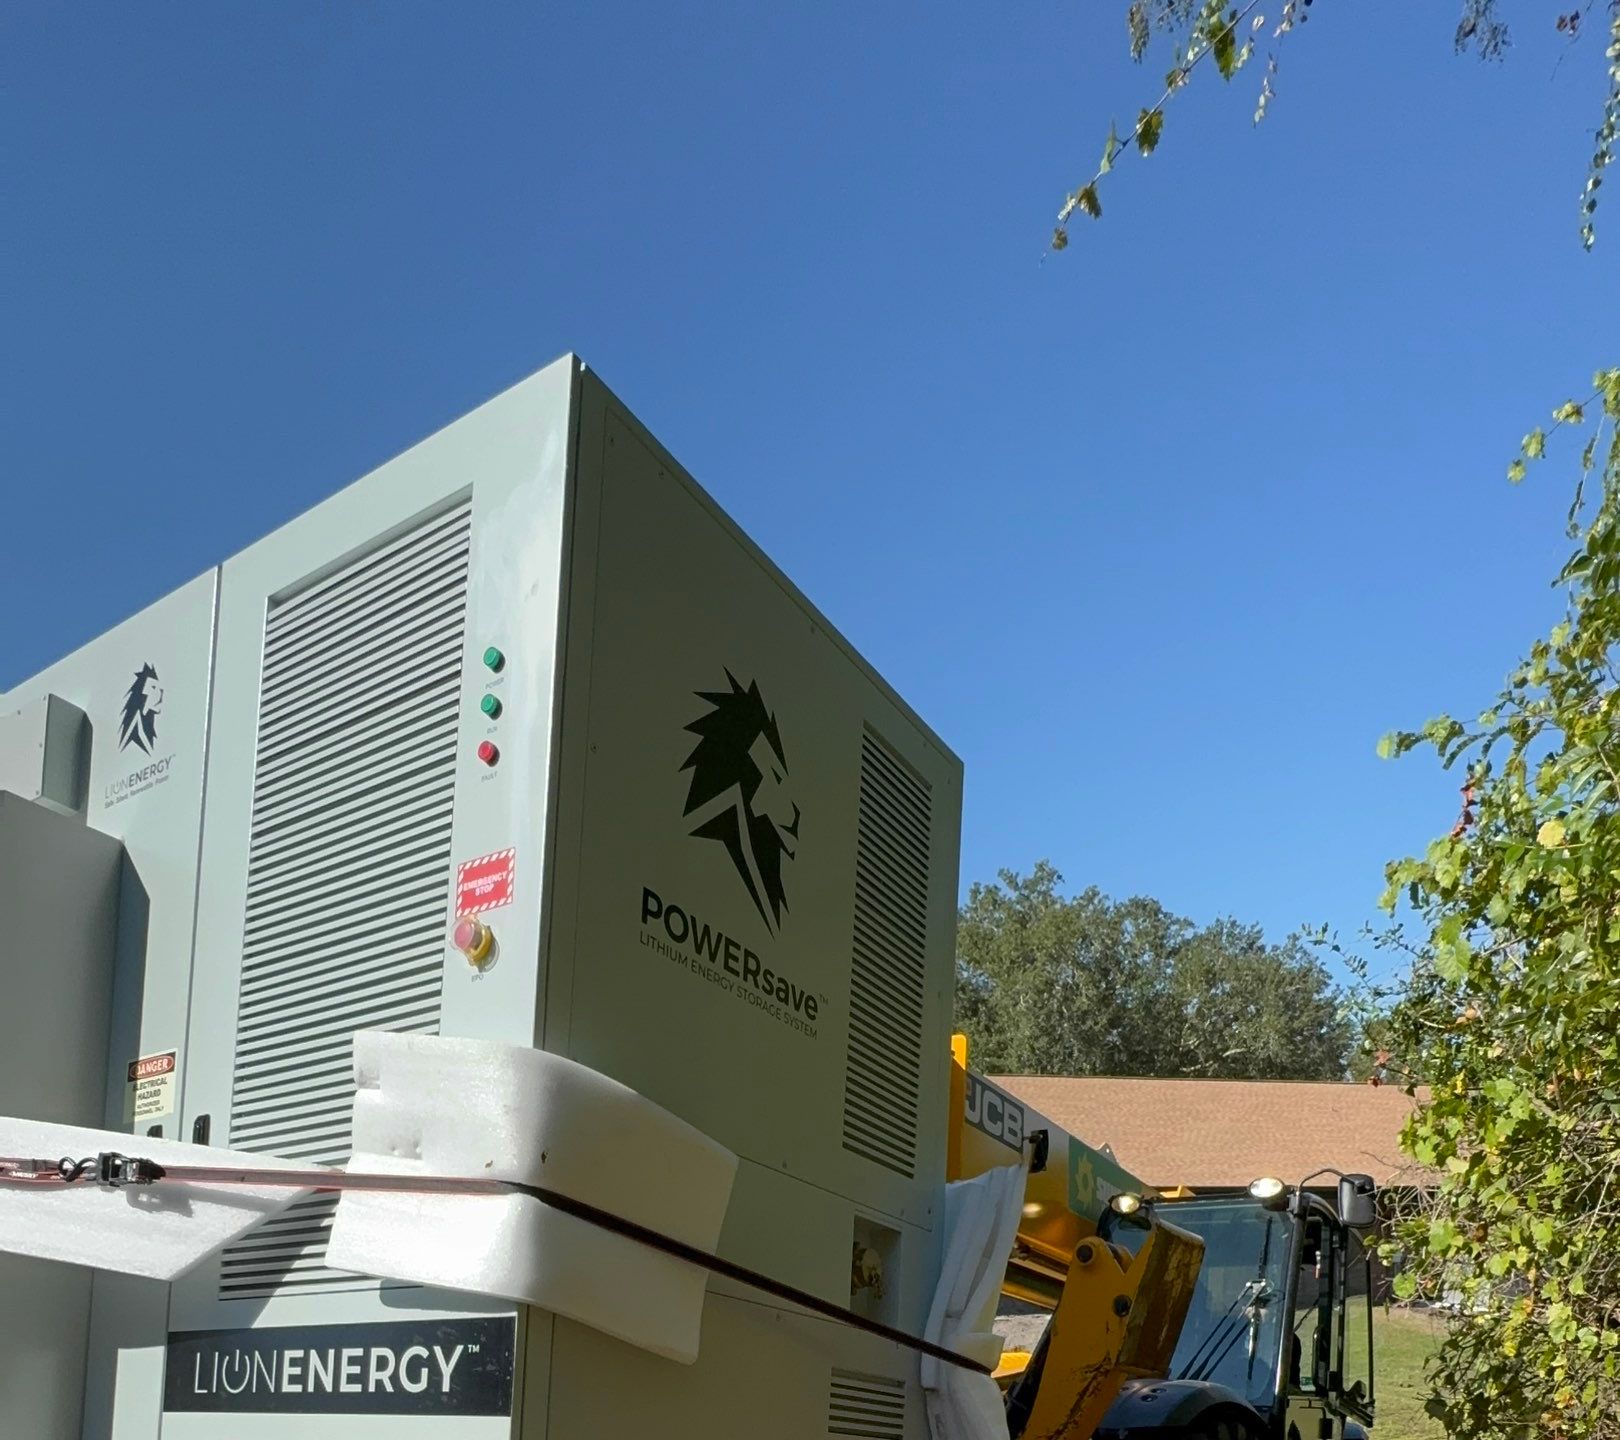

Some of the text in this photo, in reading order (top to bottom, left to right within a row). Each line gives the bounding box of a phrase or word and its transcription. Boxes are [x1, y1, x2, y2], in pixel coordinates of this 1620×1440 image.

[463, 870, 508, 892] EMERGENCY
[475, 884, 495, 897] STOP
[639, 930, 818, 1041] LITHIUM ENERGY STORAGE SYSTEM
[137, 1089, 161, 1101] HAZARD
[966, 1080, 1023, 1149] JCB
